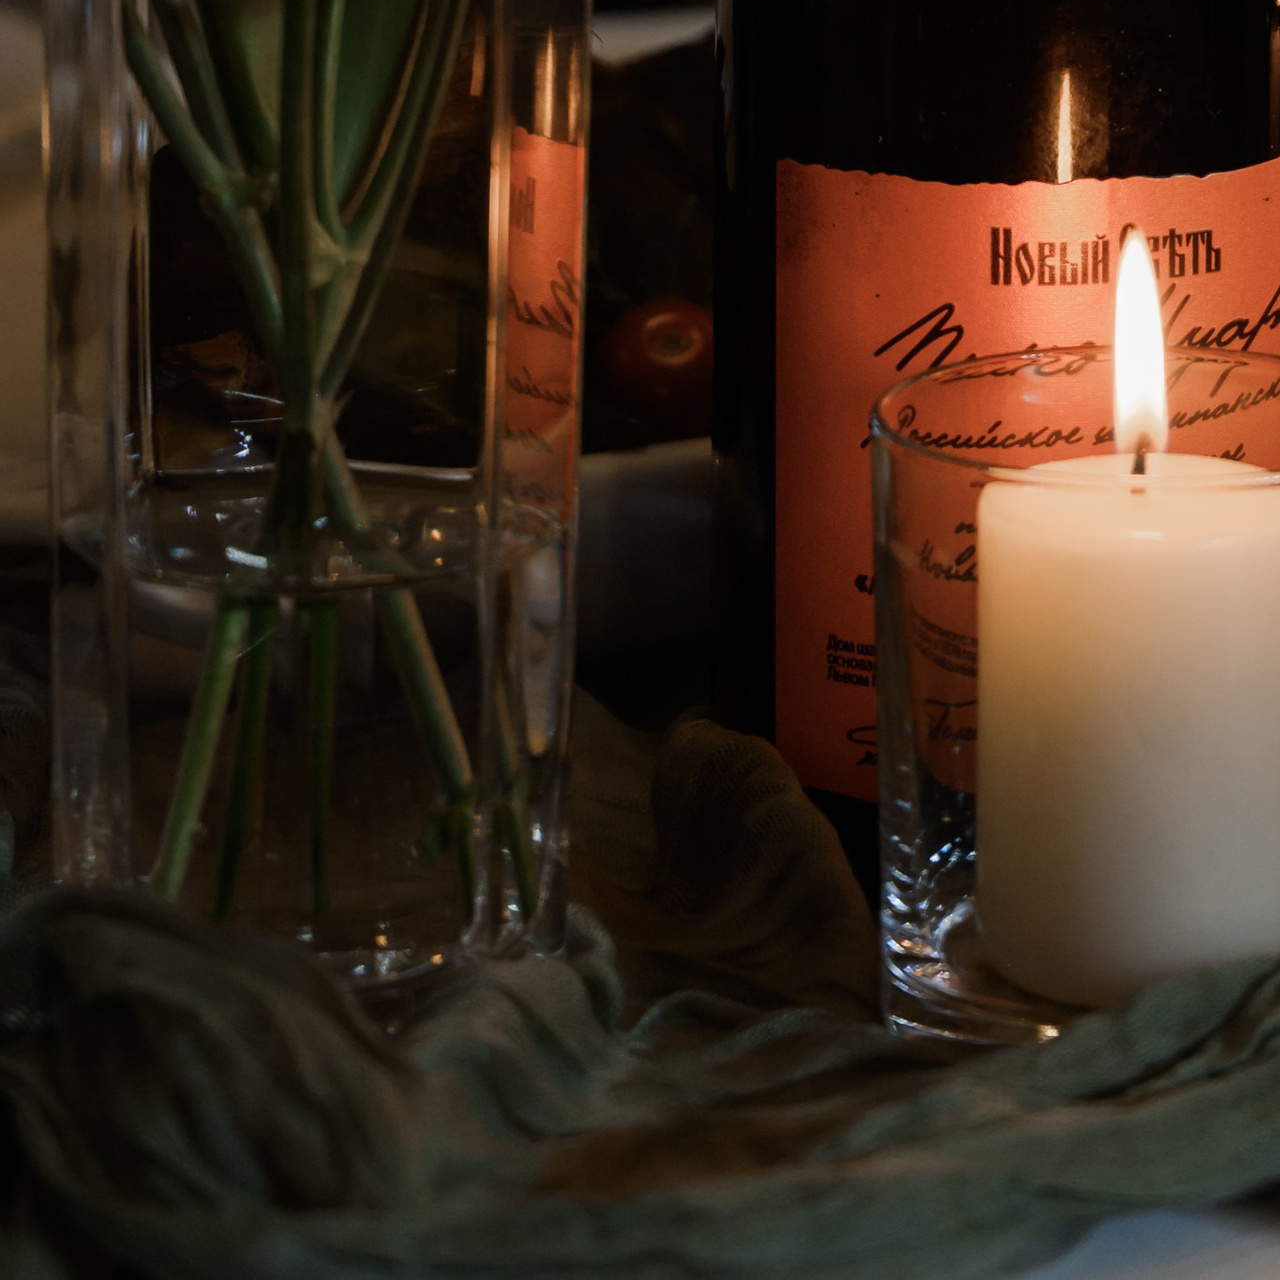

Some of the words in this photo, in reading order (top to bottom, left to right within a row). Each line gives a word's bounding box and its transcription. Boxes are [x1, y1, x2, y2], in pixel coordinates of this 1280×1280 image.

[991, 226, 1110, 286] Новый
[1119, 222, 1221, 279] ѣтъ
[827, 635, 855, 653] Дом
[827, 653, 877, 673] основа
